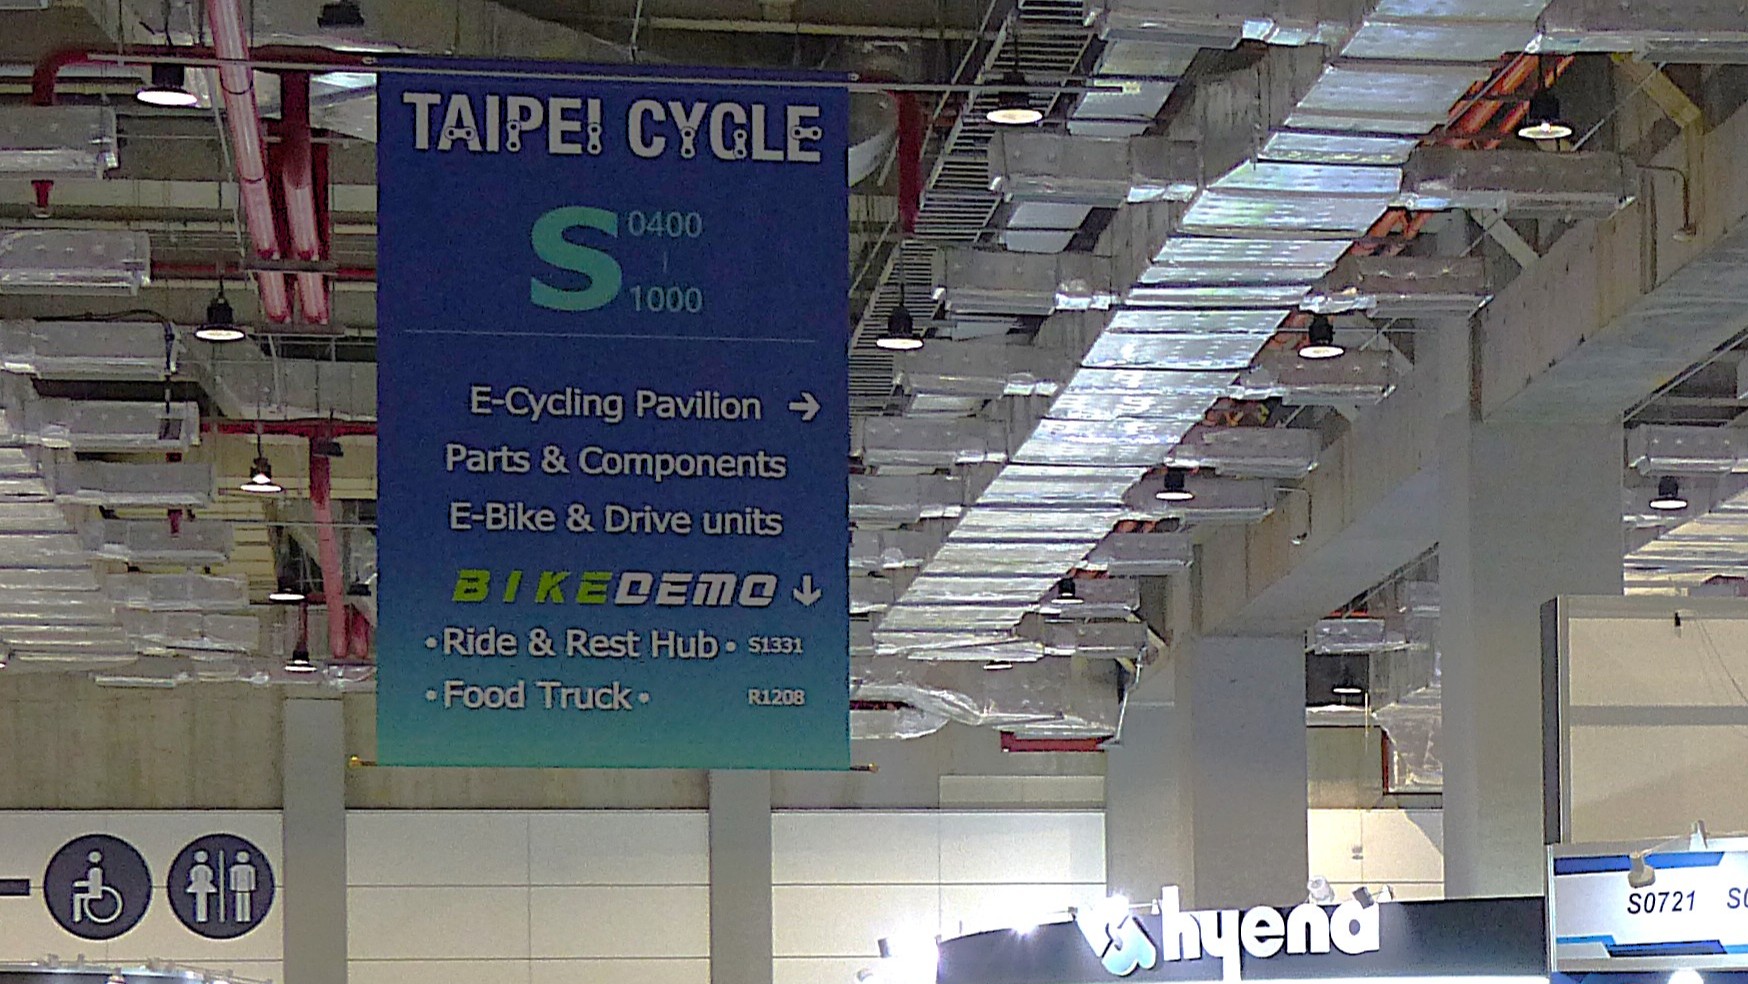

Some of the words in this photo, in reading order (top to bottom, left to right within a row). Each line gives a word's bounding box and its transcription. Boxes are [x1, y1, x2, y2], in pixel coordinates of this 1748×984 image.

[403, 92, 602, 155] TAIPEI
[628, 99, 822, 162] CYCLE
[628, 211, 702, 237] 0400
[530, 205, 622, 311] S
[630, 286, 703, 312] 1000
[470, 385, 623, 423] E-Cycling
[636, 389, 761, 420] Pavilion
[446, 444, 530, 473] Parts
[542, 446, 569, 473] &
[578, 447, 787, 481] Components
[450, 502, 556, 532] E-Bike
[566, 505, 595, 532] &
[605, 505, 691, 534] Drive
[703, 509, 784, 535] units
[528, 629, 556, 656] &
[566, 628, 641, 657] Rest
[651, 631, 718, 659] Hub
[748, 636, 803, 654] S1331
[443, 681, 525, 708] Food
[537, 681, 632, 710] Truck
[748, 688, 806, 707] R1208
[1627, 889, 1695, 914] S0721
[1162, 885, 1380, 981] hyena
